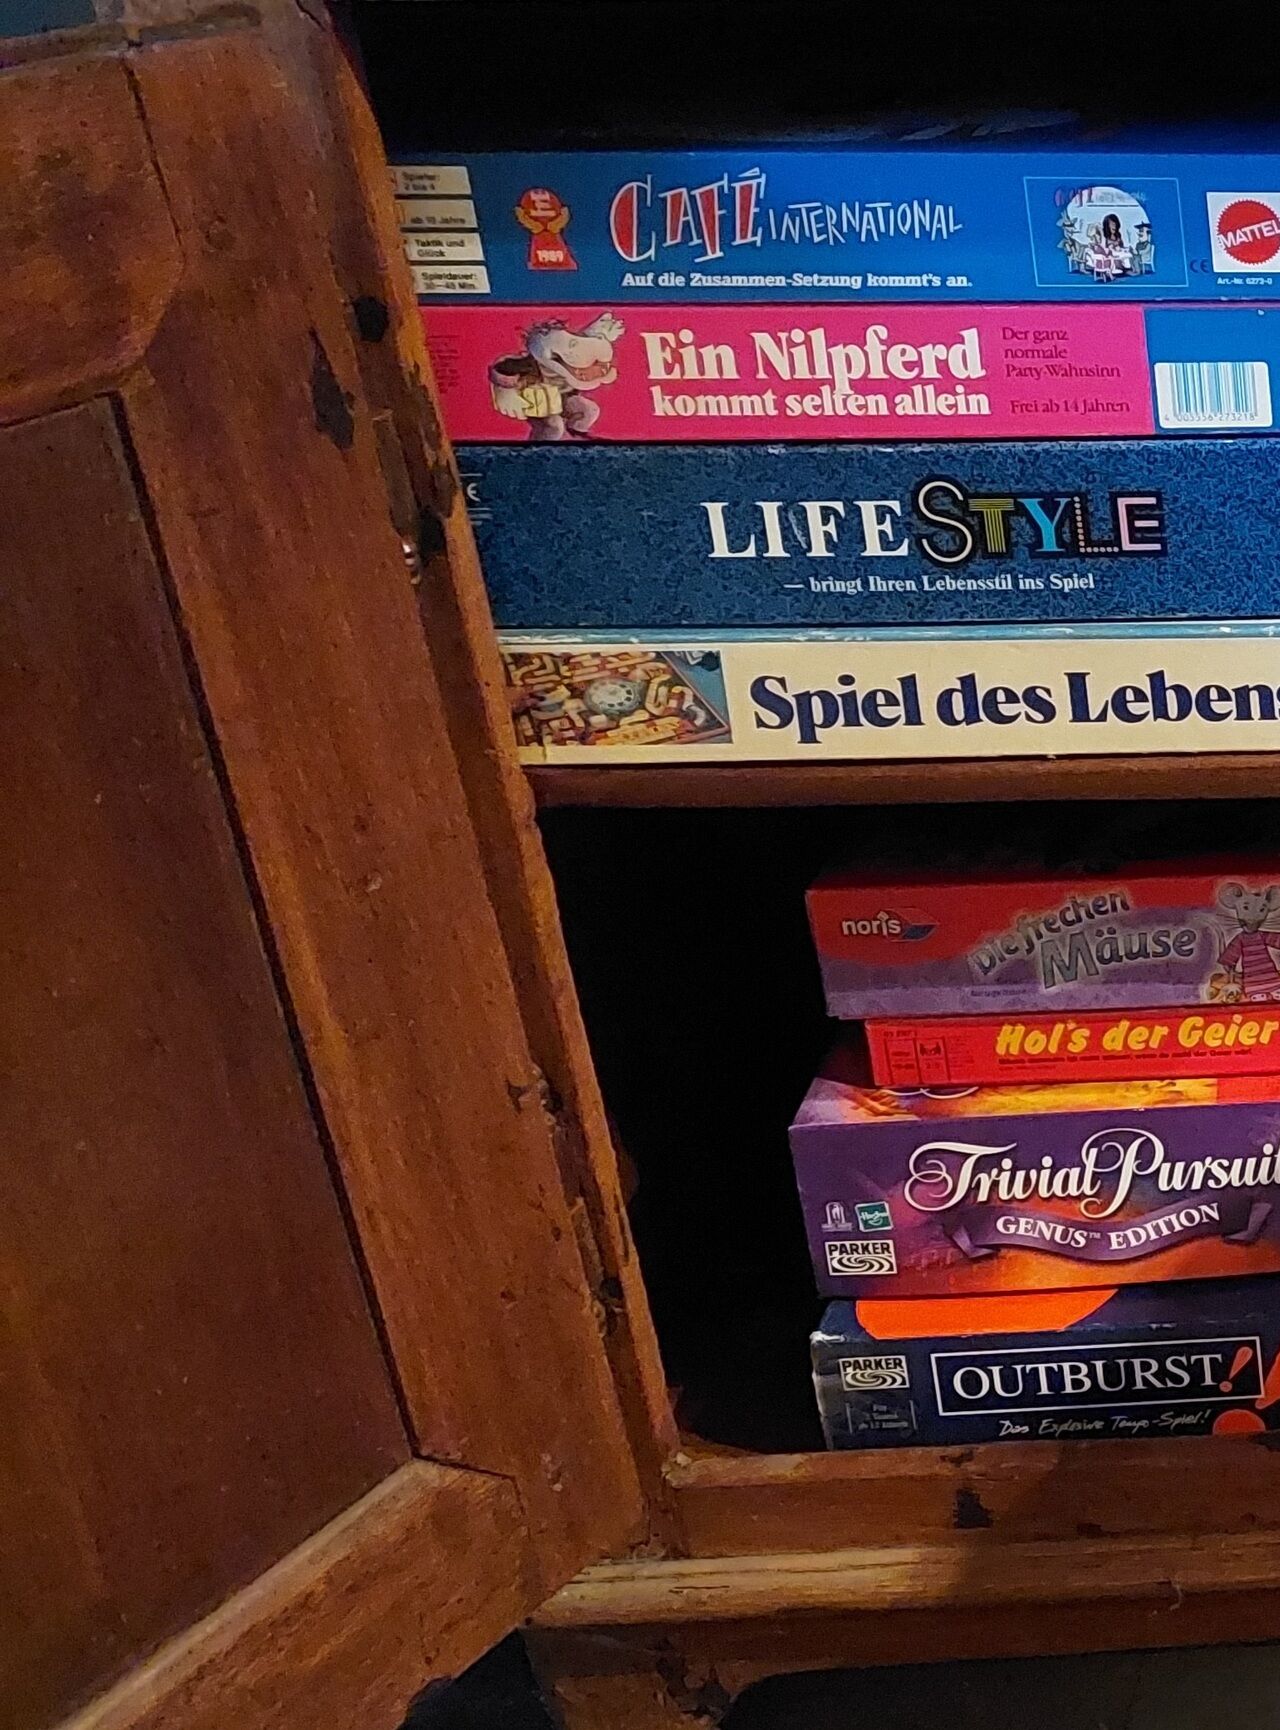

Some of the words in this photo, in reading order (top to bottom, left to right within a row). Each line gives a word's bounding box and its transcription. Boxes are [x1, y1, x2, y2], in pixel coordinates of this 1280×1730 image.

[610, 167, 765, 263] CAFÉ
[768, 199, 963, 245] INTERNATIONAL
[446, 239, 465, 248] und
[622, 272, 652, 288] Auf
[658, 272, 685, 288] die
[690, 272, 864, 291] Zusammen-Setzung
[867, 272, 941, 288] kommt's
[946, 276, 973, 288] an.
[1002, 327, 1030, 341] Der
[1032, 329, 1069, 344] ganz
[641, 328, 741, 380] Ein
[751, 325, 988, 396] Nilpferd
[1003, 345, 1068, 360] normale
[1005, 363, 1121, 379] Party-Wahnsinn
[649, 385, 779, 417] kommt
[785, 385, 890, 417] selten
[895, 384, 992, 417] allein
[1010, 400, 1039, 414] Frei
[1042, 400, 1061, 414] ab
[1063, 400, 1079, 413] 14
[1080, 400, 1131, 415] Jahren
[810, 575, 863, 595] bringt
[868, 575, 916, 592] Ihren
[922, 572, 1014, 592] Lebensstil
[1017, 573, 1045, 591] ins
[1049, 572, 1095, 593] Spiel
[749, 674, 925, 743] Spiel
[937, 672, 1056, 726] des
[841, 911, 902, 937] noris
[974, 934, 1019, 976] Die
[1017, 892, 1131, 955] frechen
[1040, 926, 1197, 990] Mäuse
[995, 1019, 1091, 1056] Hol's
[1102, 1019, 1169, 1052] der
[1177, 1014, 1280, 1049] Geier
[904, 1141, 1103, 1211] Trivial
[1109, 1203, 1221, 1250] EDITION
[828, 1242, 892, 1256] PARKER
[841, 1357, 904, 1373] PARKER
[953, 1346, 1253, 1400] OUTBURST!
[998, 1419, 1031, 1438] Das
[1038, 1417, 1106, 1438] Explosive
[1111, 1409, 1212, 1435] Tempo-Spiel!
